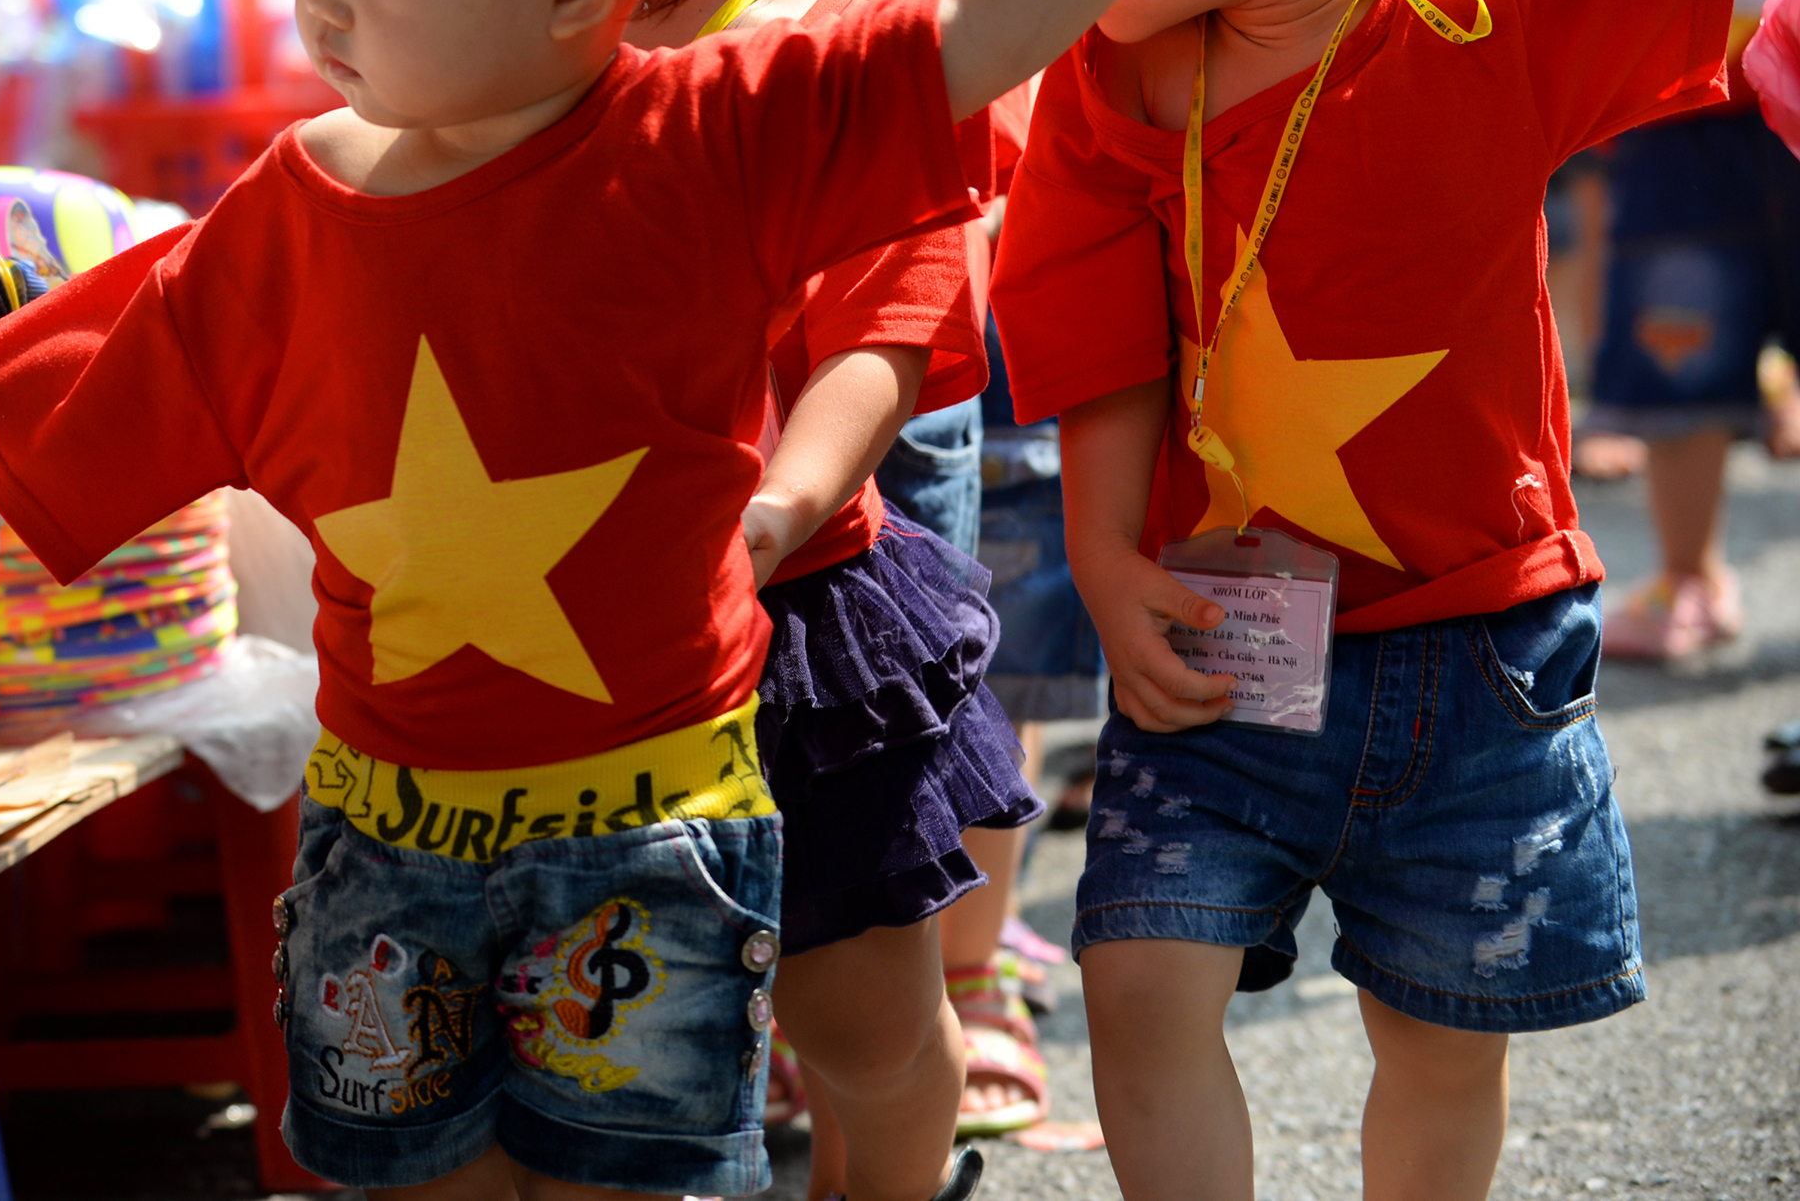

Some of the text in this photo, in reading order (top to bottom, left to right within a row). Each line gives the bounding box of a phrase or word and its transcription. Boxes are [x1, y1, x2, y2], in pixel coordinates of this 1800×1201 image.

[1433, 18, 1451, 36] SMILE
[1306, 79, 1320, 97] SMILE
[1292, 112, 1306, 133] SMILE
[1281, 147, 1294, 168] SMILE
[1269, 182, 1282, 203] SMILE
[1259, 217, 1270, 238] SMILE
[1247, 252, 1258, 272] SMILE
[1230, 285, 1242, 304] SMILE
[1233, 610, 1258, 622] Minh
